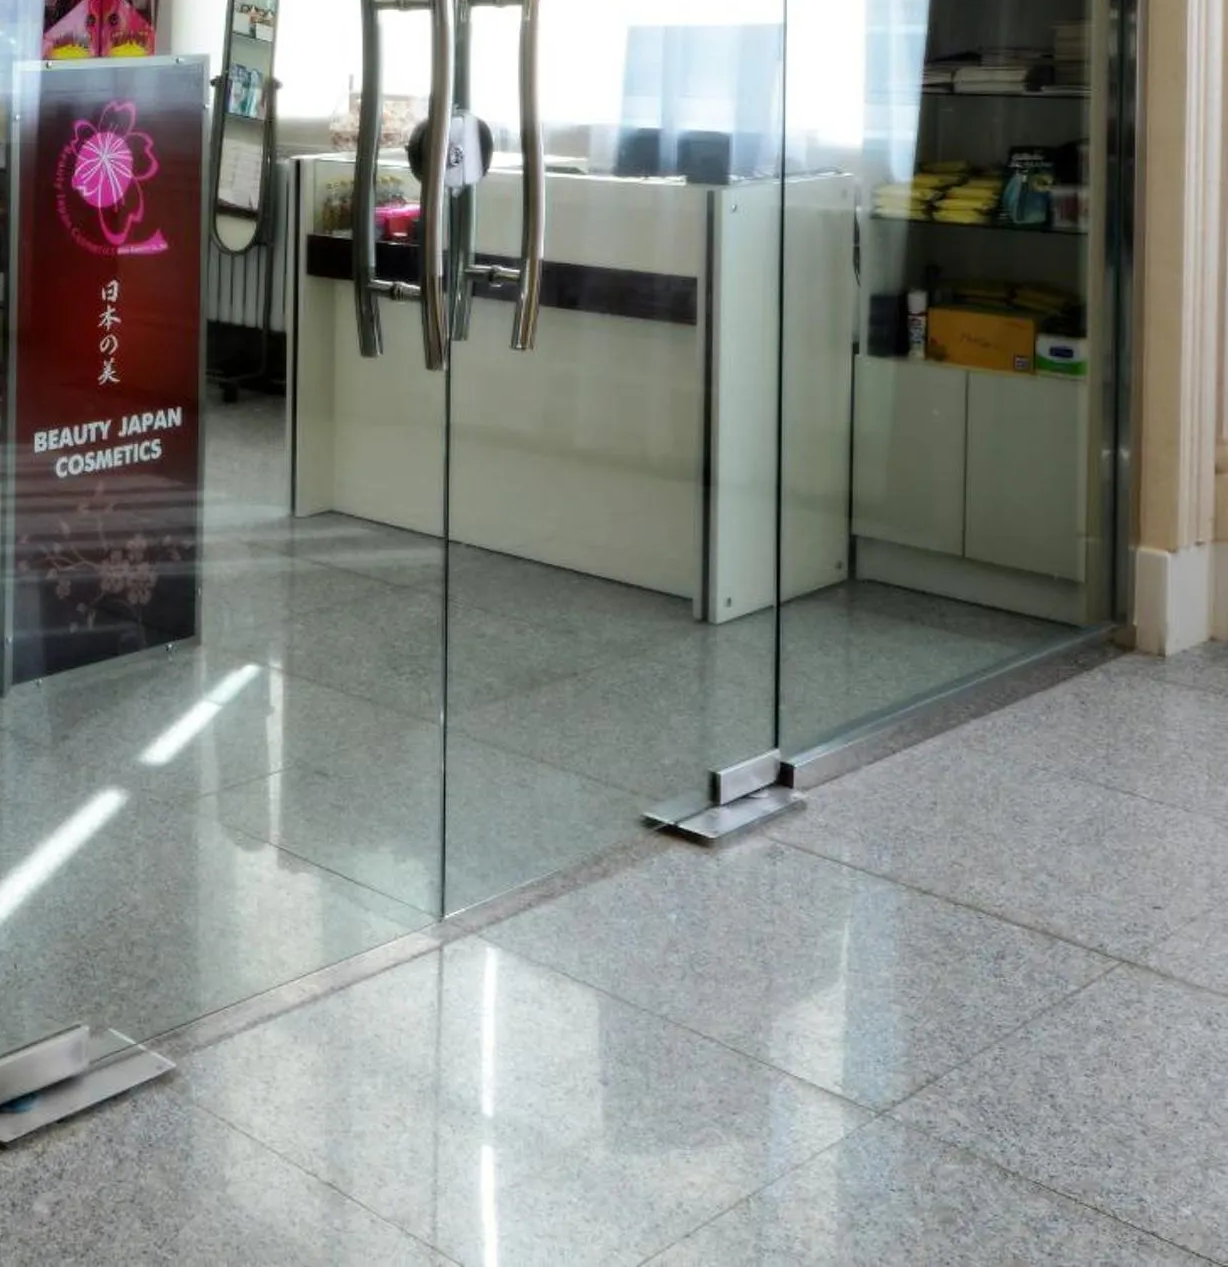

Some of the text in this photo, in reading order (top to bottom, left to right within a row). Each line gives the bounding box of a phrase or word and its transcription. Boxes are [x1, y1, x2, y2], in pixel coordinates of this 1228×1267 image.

[97, 279, 122, 386] 日本の美
[33, 406, 183, 454] BEAUTY JAPAN
[54, 438, 163, 479] COSMETICS
